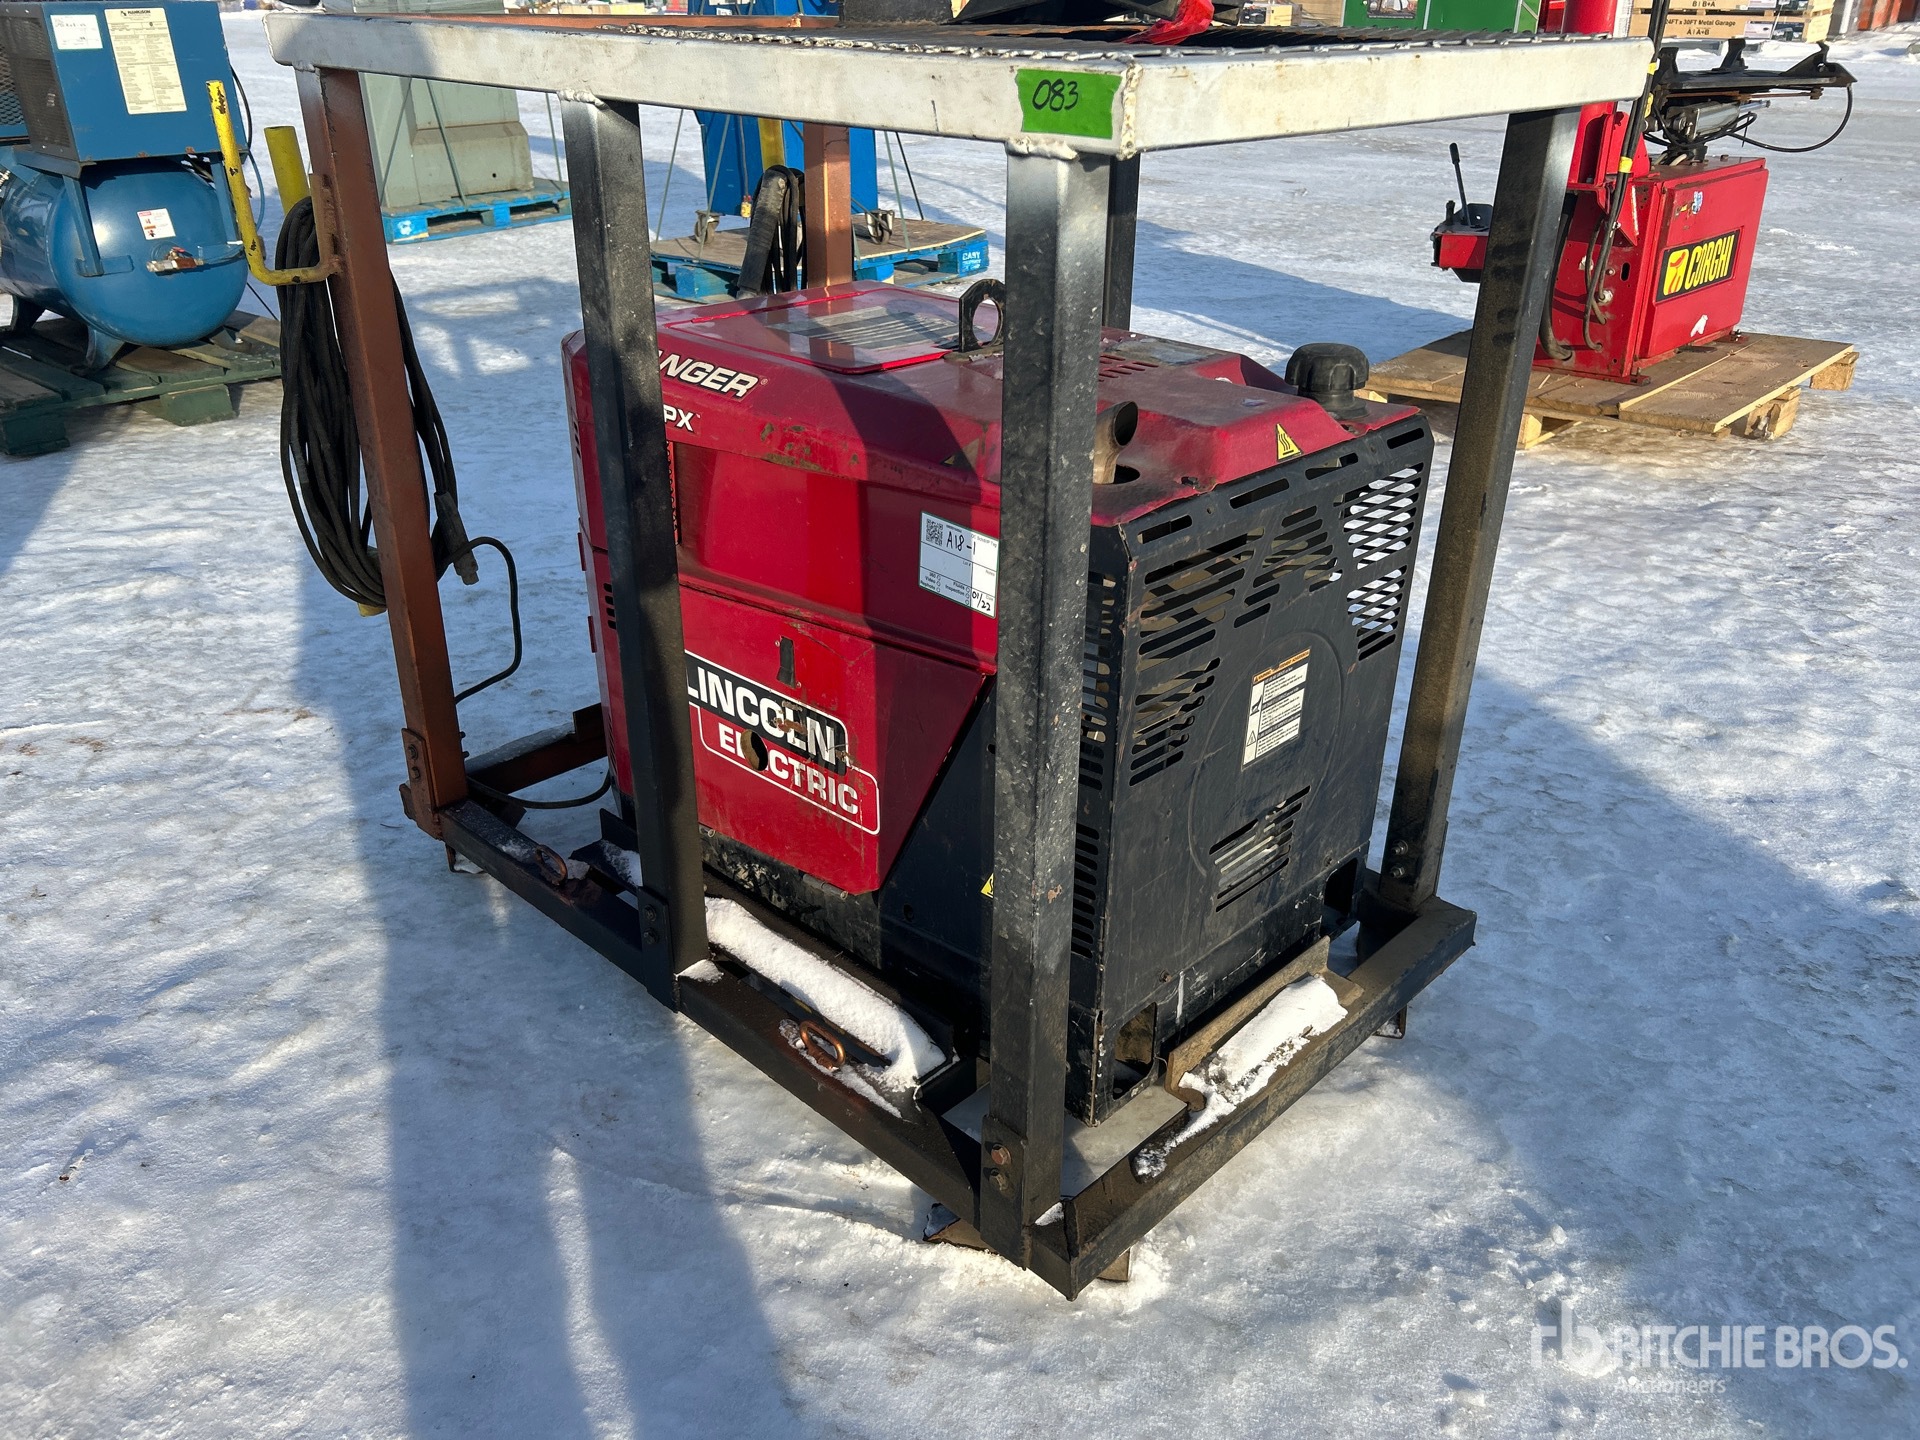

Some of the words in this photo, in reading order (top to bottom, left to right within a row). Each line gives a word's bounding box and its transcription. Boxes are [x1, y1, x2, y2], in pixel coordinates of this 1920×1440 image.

[1032, 78, 1078, 112] 083
[1684, 234, 1735, 290] CORGHI
[658, 350, 758, 398] NGER
[945, 584, 965, 596] Inspection
[719, 722, 858, 815] ELCTRIC
